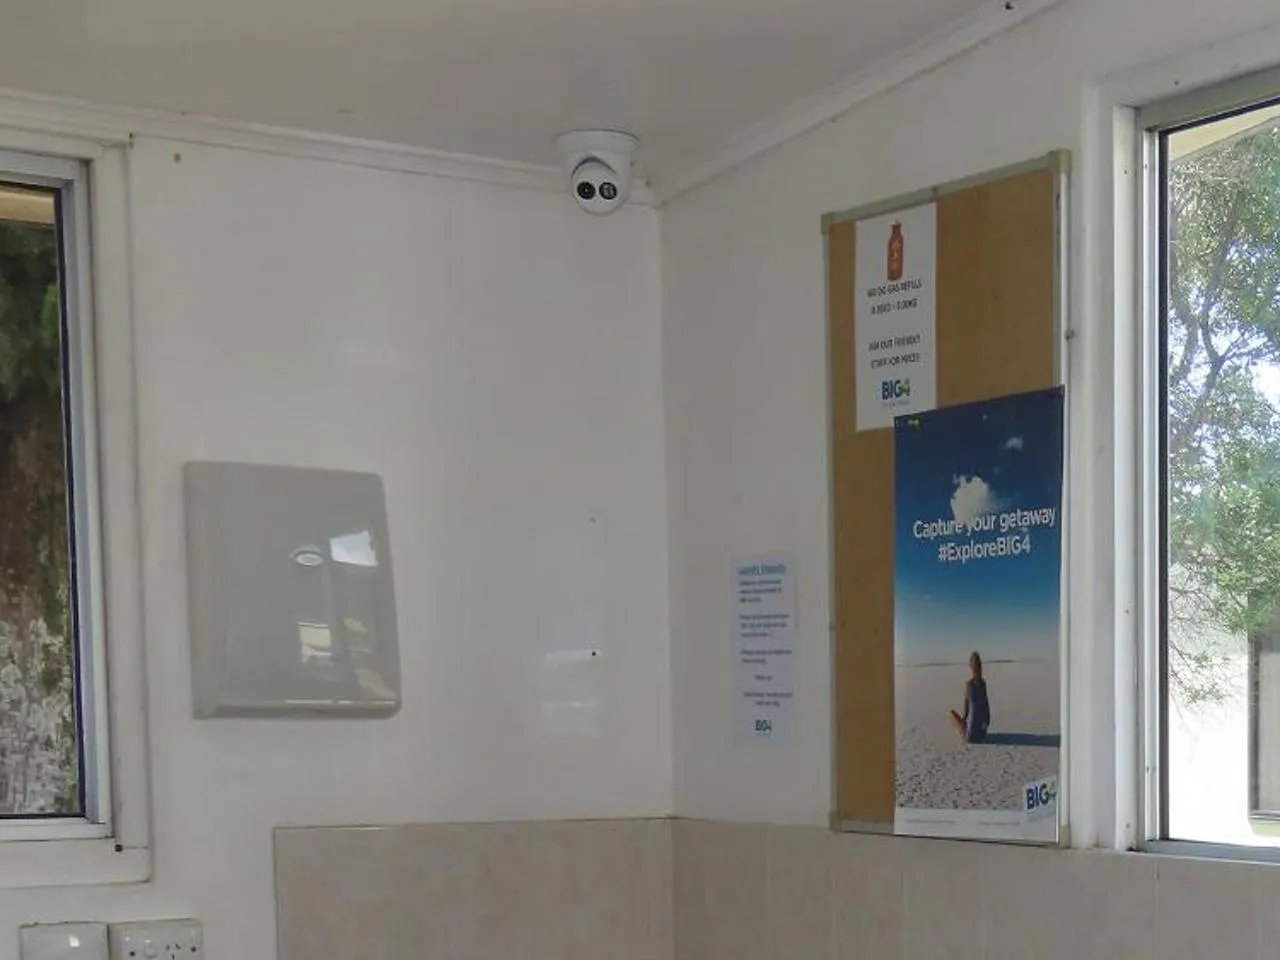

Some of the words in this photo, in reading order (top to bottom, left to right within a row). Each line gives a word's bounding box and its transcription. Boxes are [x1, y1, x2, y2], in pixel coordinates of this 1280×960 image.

[881, 378, 911, 401] BIG4
[912, 517, 963, 541] Capture
[966, 513, 997, 537] your
[1000, 506, 1056, 533] getaway
[937, 533, 1032, 565] #ExploreBIG4
